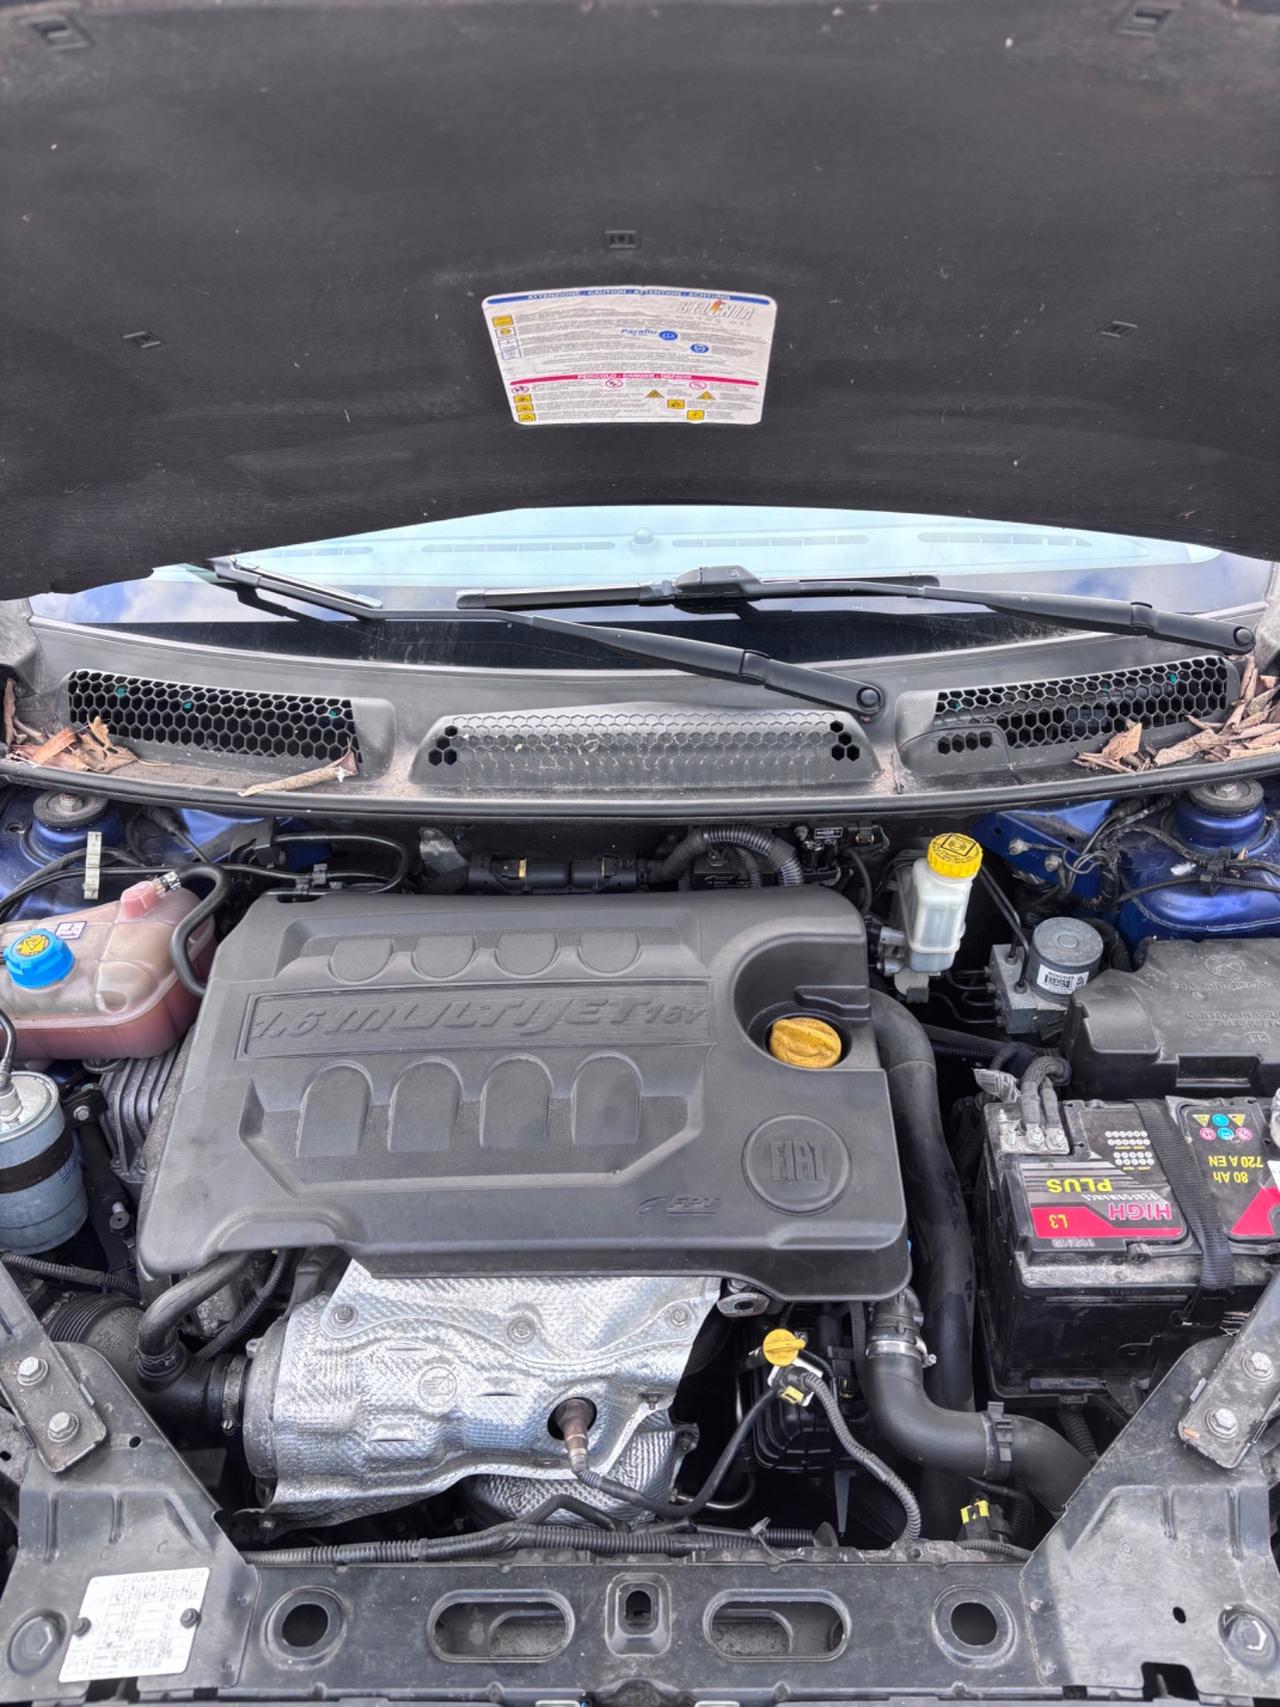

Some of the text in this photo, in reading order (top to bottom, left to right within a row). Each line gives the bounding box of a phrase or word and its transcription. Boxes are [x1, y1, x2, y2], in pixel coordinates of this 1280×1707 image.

[251, 1007, 327, 1040] 1.6
[320, 996, 652, 1036] MULTIJET
[770, 1141, 829, 1183] FIAT
[1208, 1155, 1264, 1168] 720 A EN
[1047, 1178, 1113, 1193] PLUS
[1213, 1171, 1249, 1184] 80 Ah
[1109, 1202, 1172, 1221] HIGH
[1049, 1214, 1069, 1230] L3
